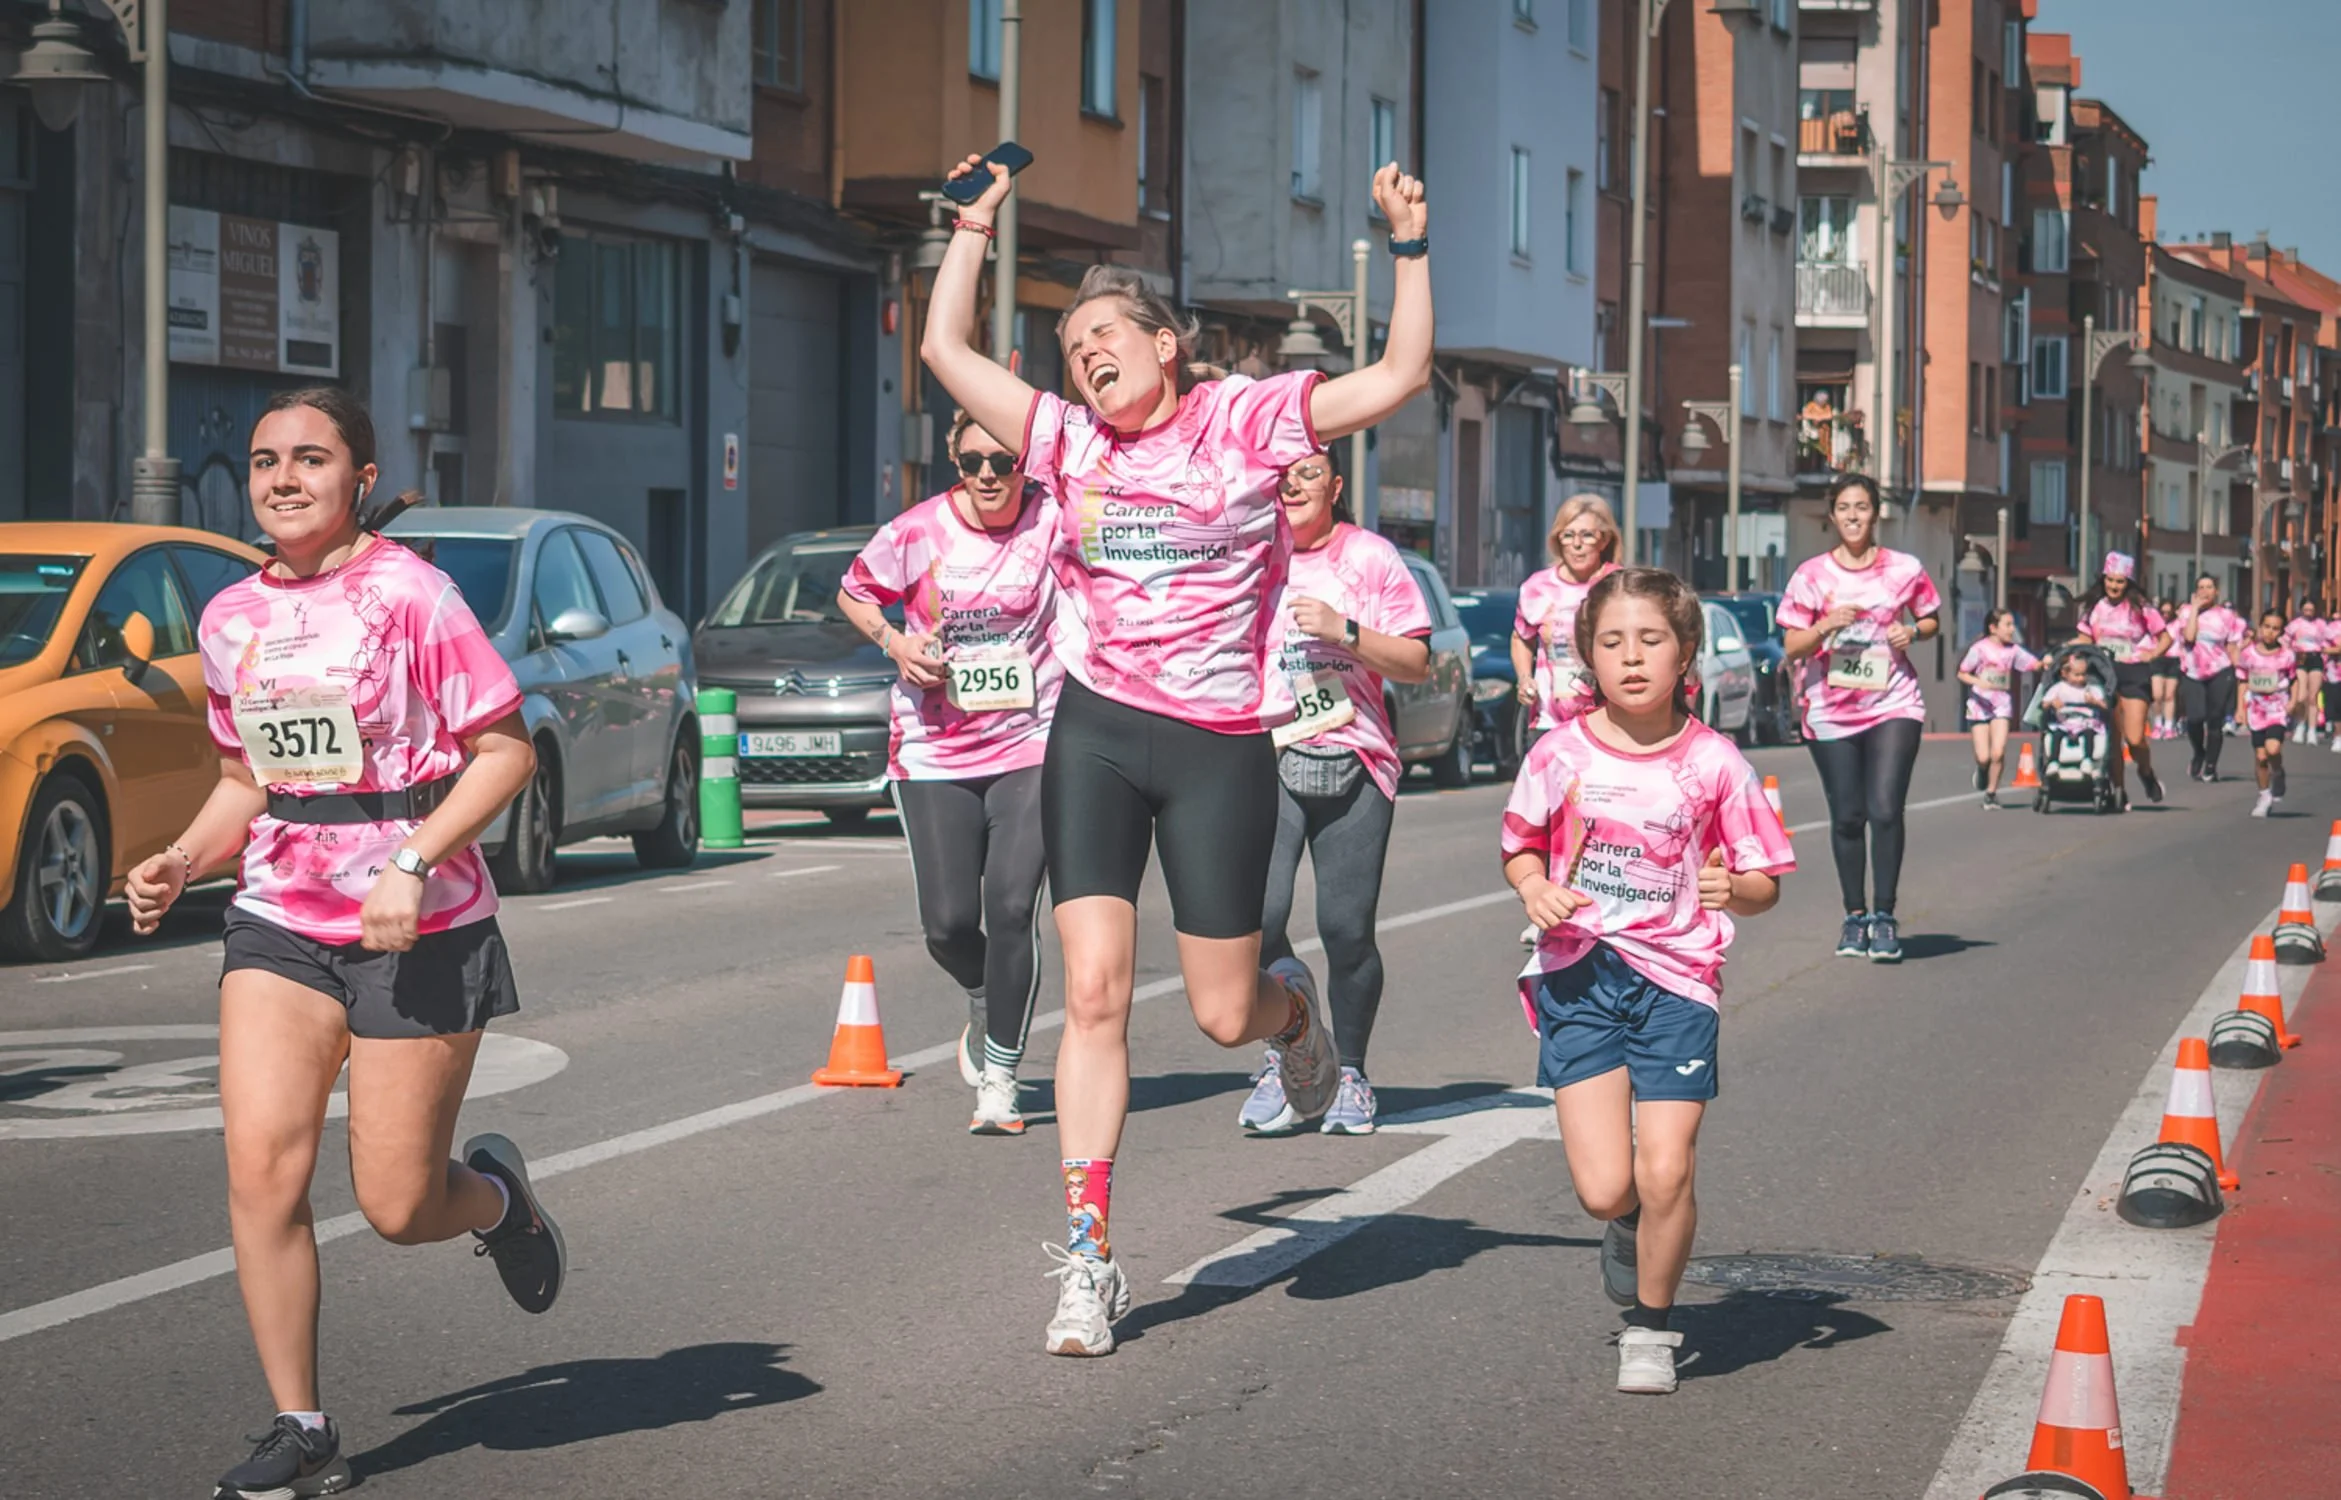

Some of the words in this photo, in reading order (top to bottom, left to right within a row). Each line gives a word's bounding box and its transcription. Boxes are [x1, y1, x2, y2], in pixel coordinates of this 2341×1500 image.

[229, 222, 271, 248] VINOS
[223, 250, 276, 278] MIGUEL
[1103, 502, 1175, 518] Carrera
[1102, 525, 1134, 543] por
[1137, 523, 1156, 539] la
[1104, 544, 1227, 564] Investigación
[941, 606, 999, 619] Carrera
[943, 624, 967, 633] por
[969, 622, 984, 632] la
[1843, 659, 1874, 678] 266
[960, 666, 1019, 692] 2956
[259, 717, 342, 758] 3572
[803, 736, 835, 752] JMH
[1583, 834, 1641, 858] Carrera
[1581, 857, 1605, 873] por
[1608, 860, 1621, 878] la
